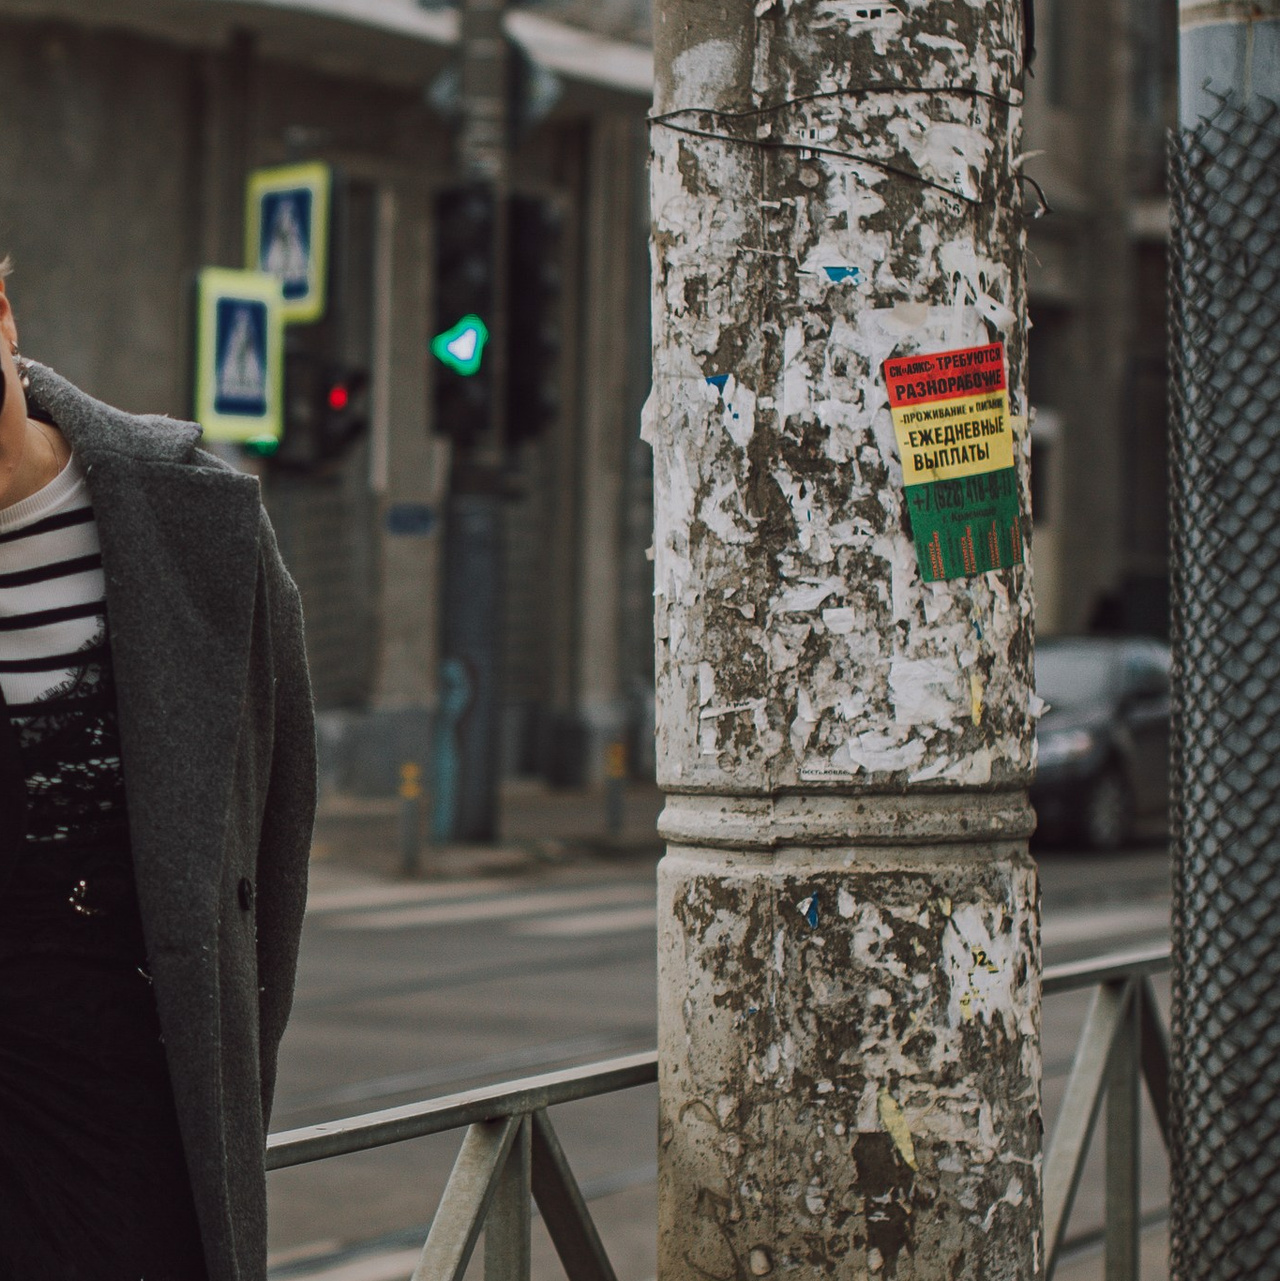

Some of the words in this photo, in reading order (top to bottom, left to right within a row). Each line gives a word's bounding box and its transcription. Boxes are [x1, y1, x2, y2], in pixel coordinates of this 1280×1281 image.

[936, 348, 1001, 371] ТРЕБУЮТСЯ
[895, 369, 1001, 401] РАЗНОРАБОЧИЕ
[913, 442, 990, 471] ВЫПЛАТЫ
